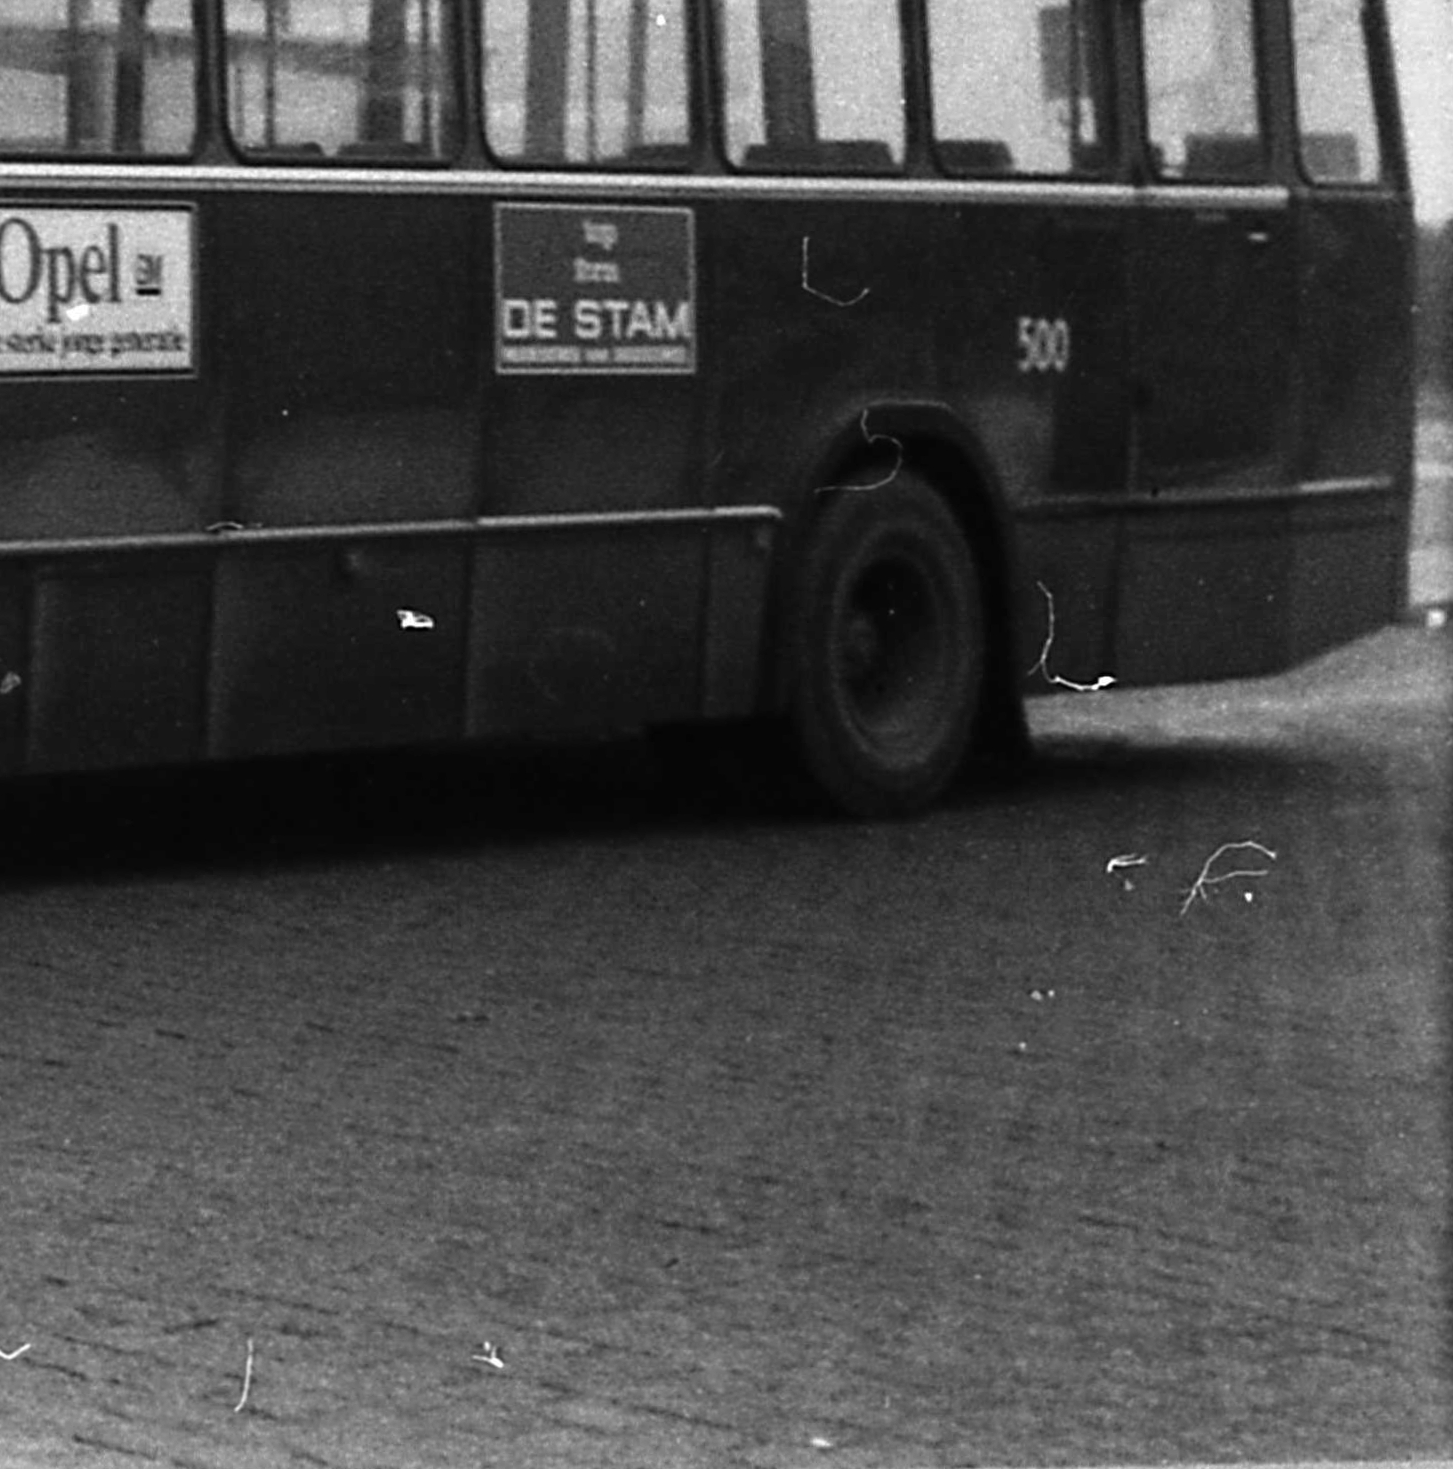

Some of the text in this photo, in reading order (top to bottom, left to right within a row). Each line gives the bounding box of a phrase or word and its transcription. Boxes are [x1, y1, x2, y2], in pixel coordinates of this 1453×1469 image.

[502, 298, 692, 339] DE STAM
[1017, 316, 1070, 372] 500
